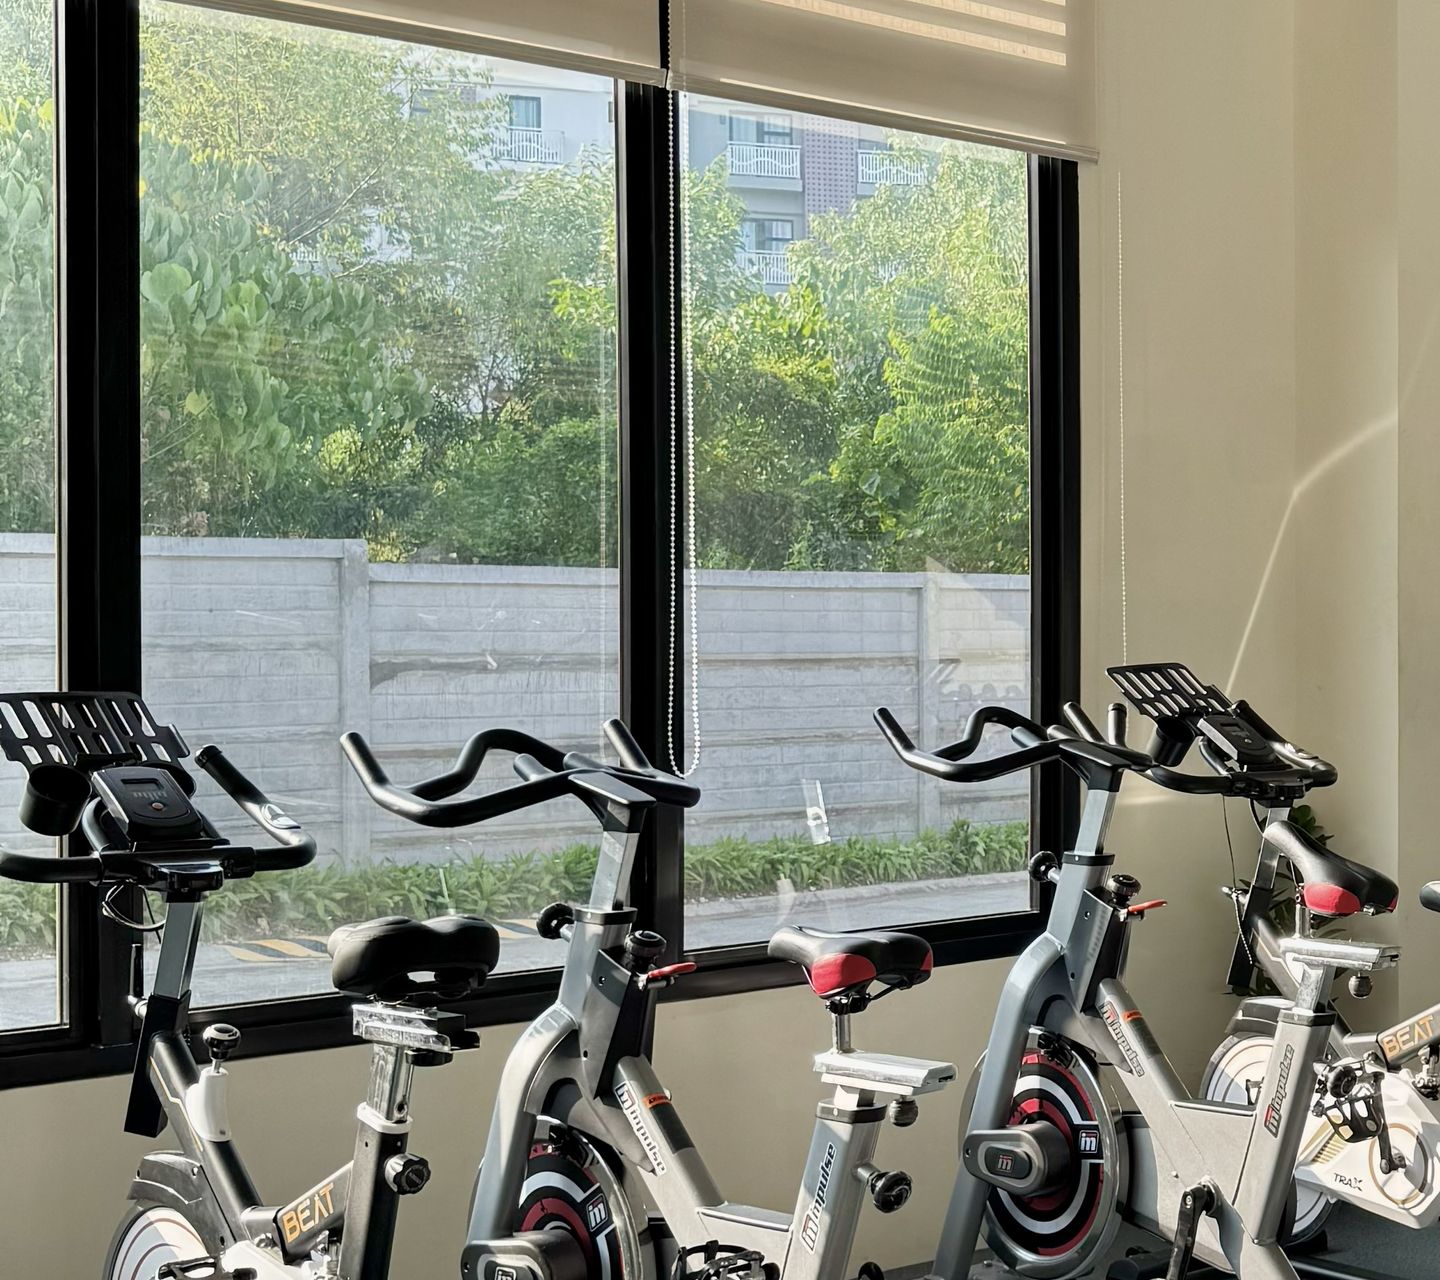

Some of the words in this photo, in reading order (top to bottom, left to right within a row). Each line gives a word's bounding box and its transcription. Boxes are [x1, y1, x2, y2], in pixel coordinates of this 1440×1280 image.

[1382, 1014, 1433, 1058] BEAT
[1271, 1043, 1294, 1115] impulse
[282, 1182, 334, 1243] BEAT
[812, 1142, 836, 1220] impulse
